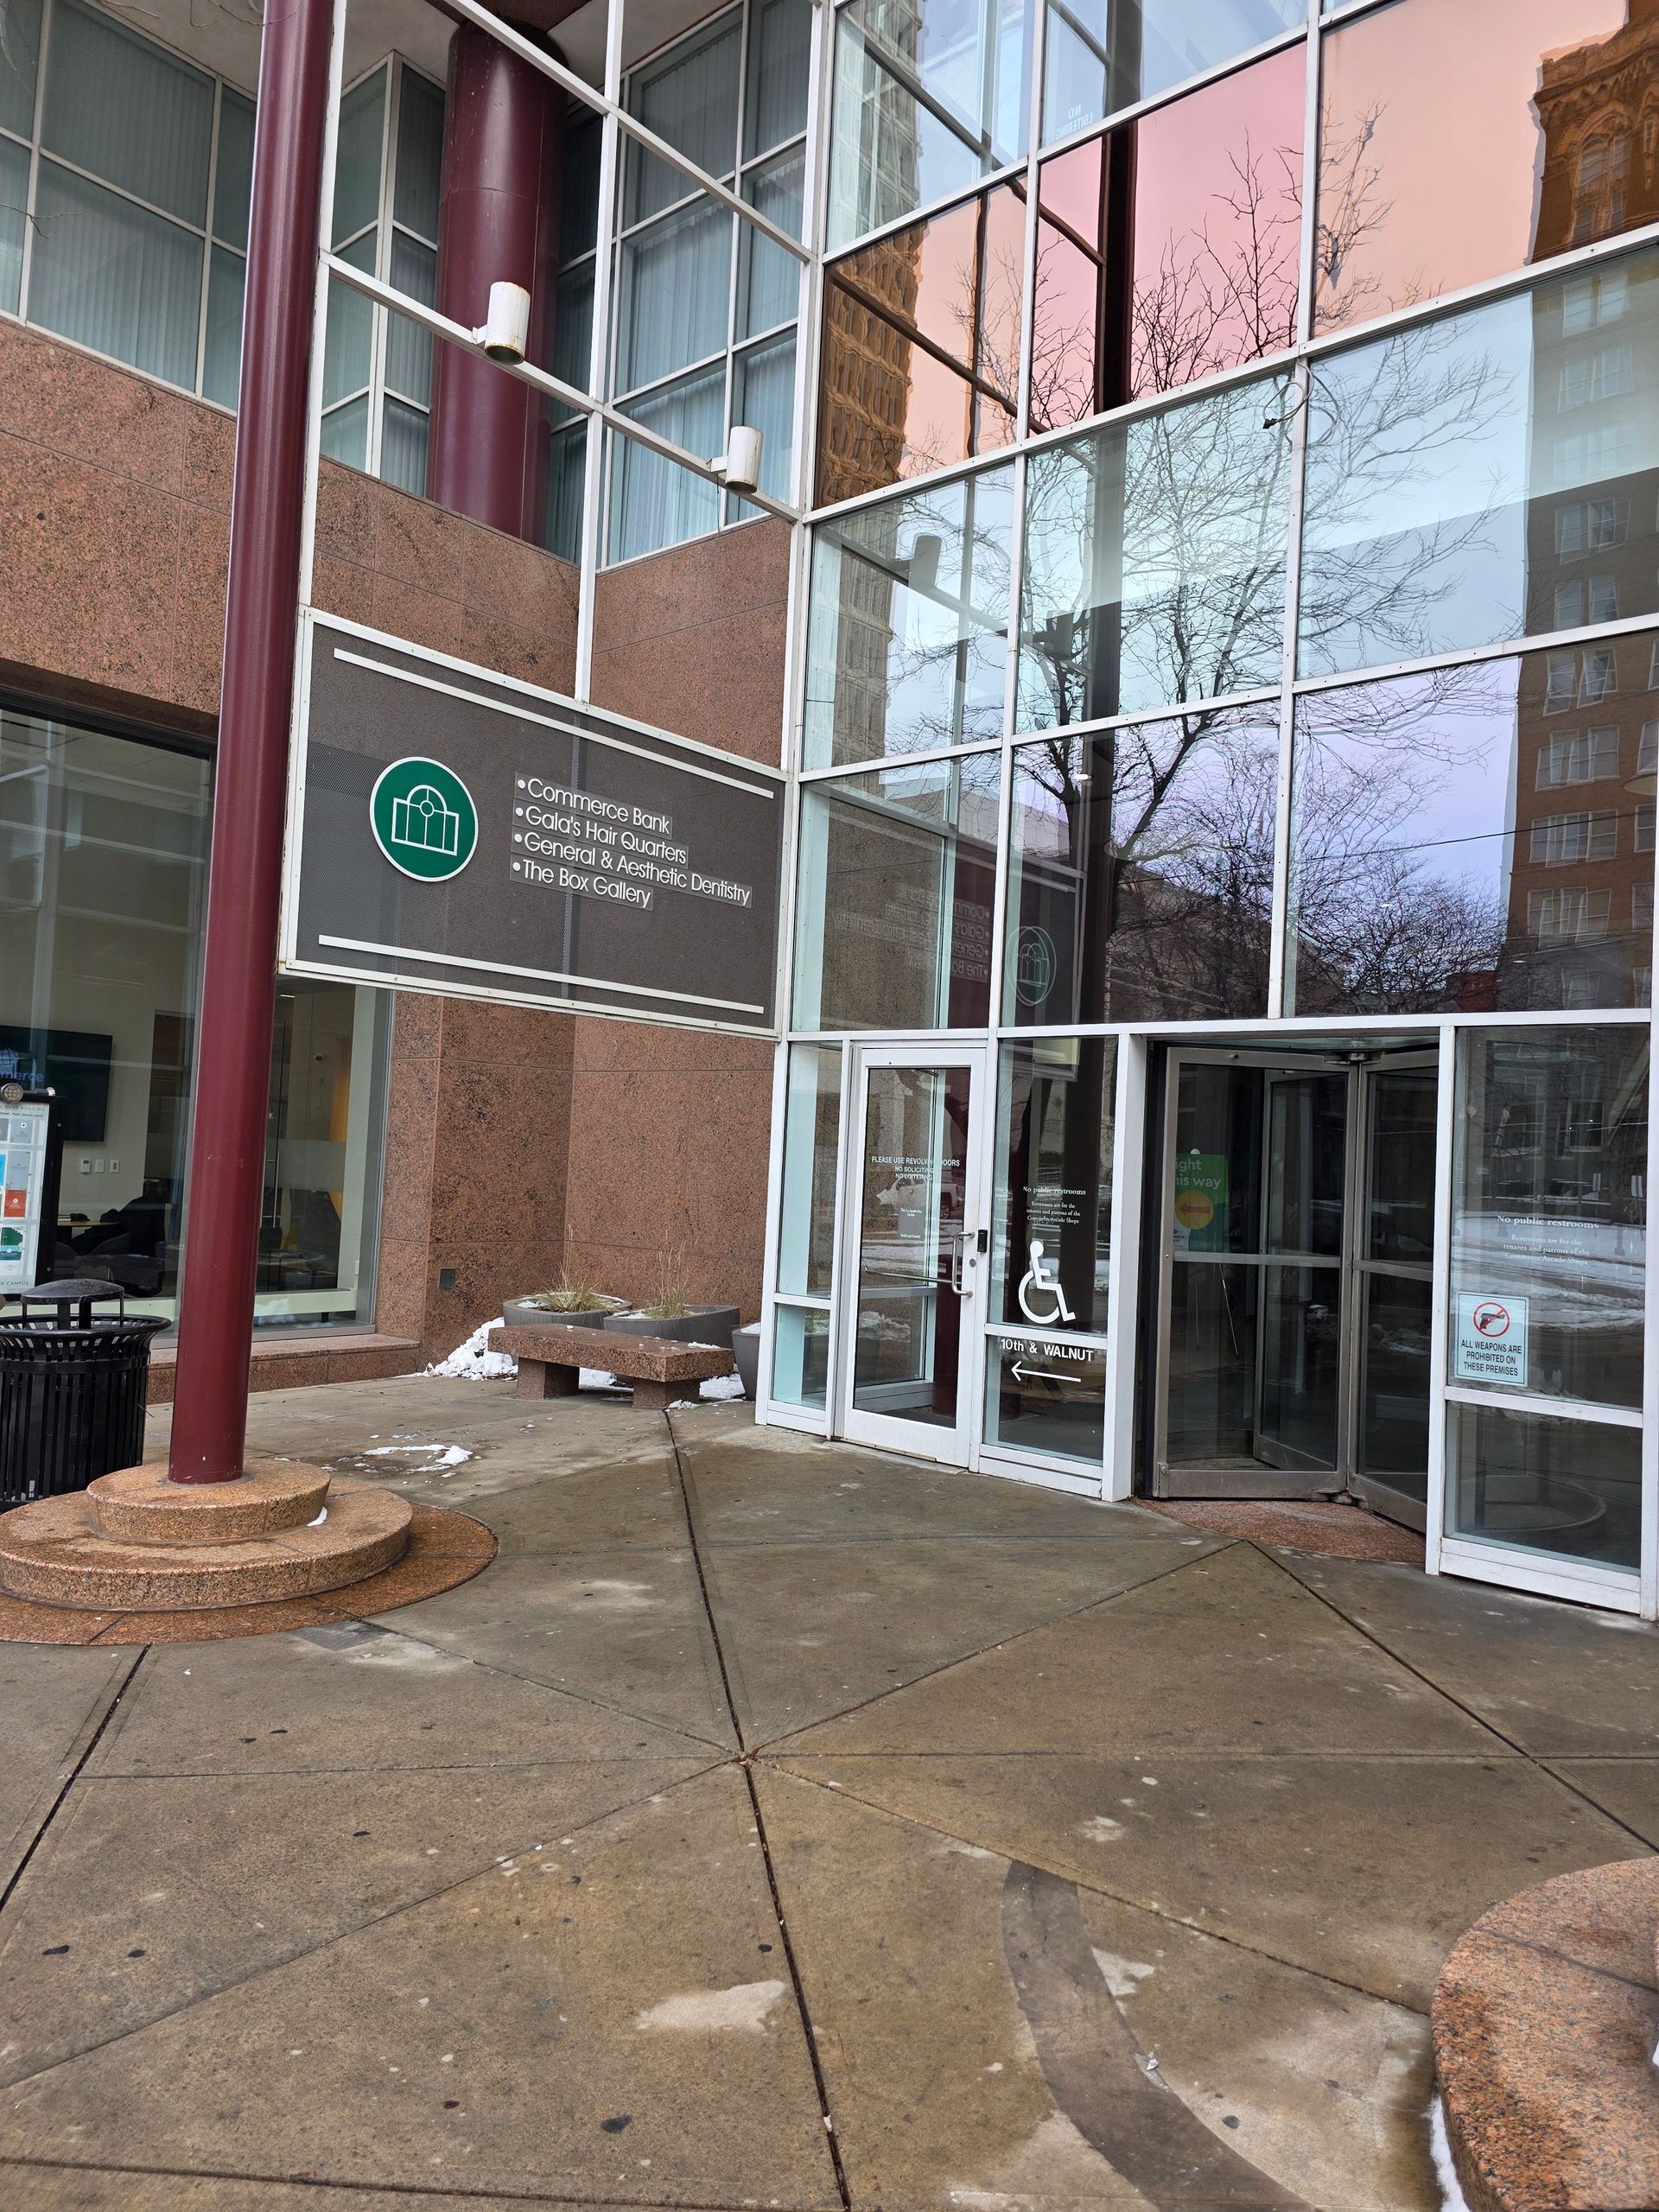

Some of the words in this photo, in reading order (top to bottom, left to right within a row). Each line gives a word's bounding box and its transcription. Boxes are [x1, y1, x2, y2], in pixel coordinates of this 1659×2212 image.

[527, 778, 629, 823] Commerce
[632, 807, 671, 835] Bank
[525, 805, 582, 837] Gala's
[585, 820, 618, 846] Hair
[620, 832, 688, 865] Quarters
[524, 831, 596, 867] General
[601, 850, 613, 871] &
[616, 855, 688, 889] Aesthetic
[690, 873, 751, 906] Dentistry
[522, 859, 555, 884] The
[558, 868, 589, 893] Box
[593, 876, 652, 908] Gallery
[1175, 1157, 1203, 1173] ight
[1192, 1175, 1222, 1190] way
[1513, 1216, 1545, 1225] public
[1547, 1219, 1599, 1230] restrooms
[1511, 1233, 1546, 1243] Restrooms
[1559, 1236, 1570, 1245] for
[1504, 1251, 1541, 1261] Commerce
[1541, 1255, 1566, 1264] Arcade
[1567, 1256, 1588, 1266] Shops
[1579, 1249, 1590, 1257] the
[1001, 1338, 1024, 1352] 10th
[1029, 1343, 1038, 1354] &
[1044, 1344, 1094, 1362] WALNUT
[1460, 1338, 1473, 1350] ALL
[1474, 1340, 1507, 1353] WEAPONS
[1508, 1344, 1522, 1355] ARE
[1465, 1351, 1505, 1365] PROHIBITED
[1506, 1356, 1516, 1365] ON
[1463, 1361, 1484, 1372] THESE
[1485, 1364, 1518, 1376] PREMISES
